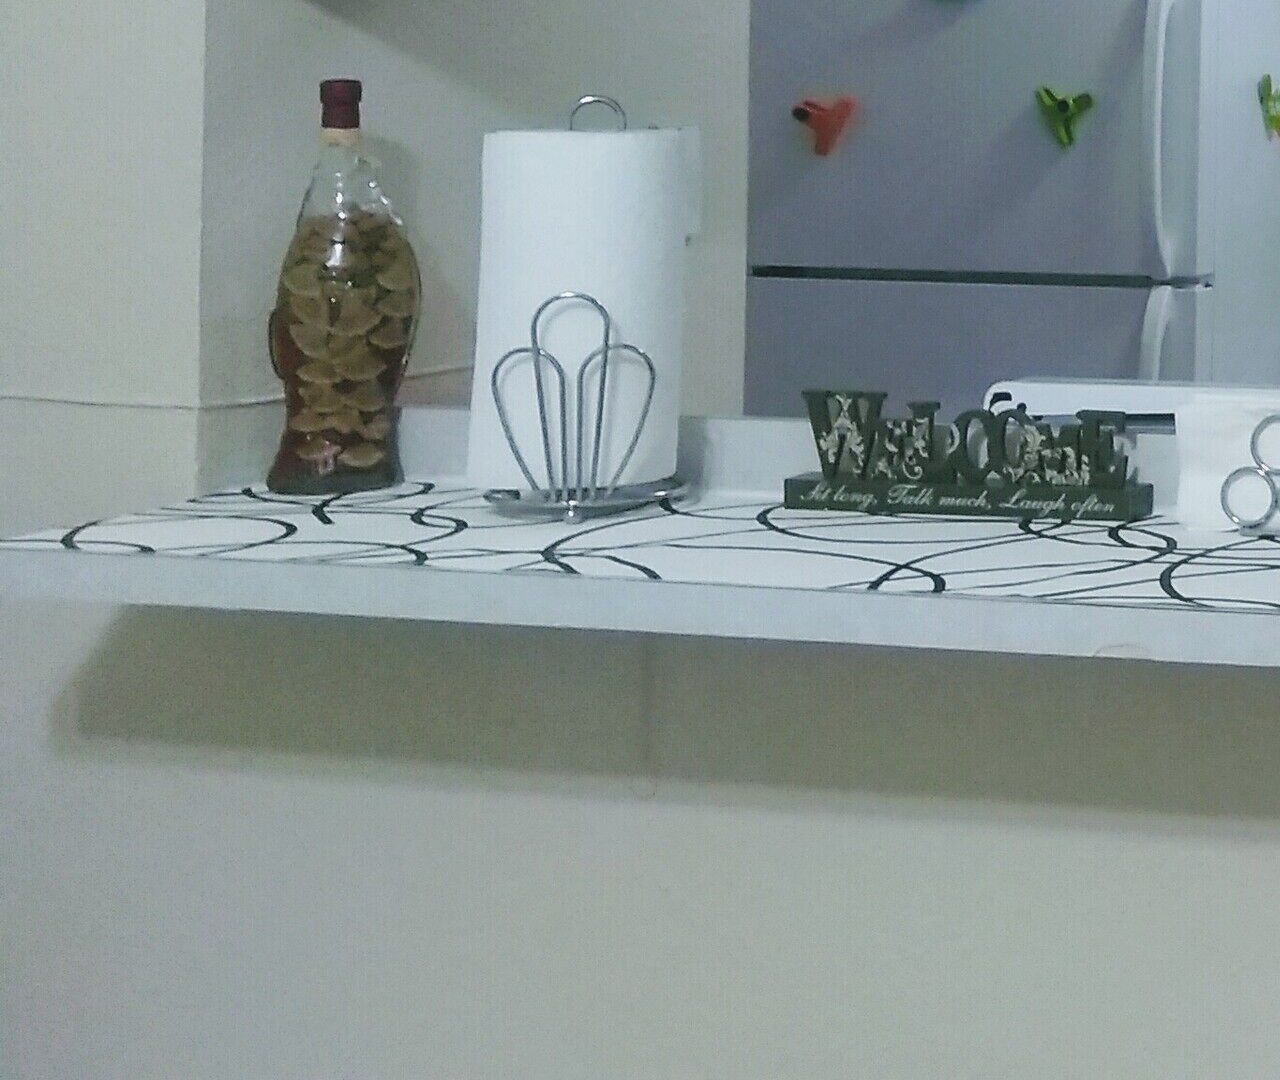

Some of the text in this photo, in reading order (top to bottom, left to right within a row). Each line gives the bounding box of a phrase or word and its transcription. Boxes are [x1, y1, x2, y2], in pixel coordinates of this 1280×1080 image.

[886, 483, 934, 506] Talk
[938, 492, 992, 510] much,
[1000, 488, 1066, 517] Laugh
[1070, 493, 1116, 518] often
